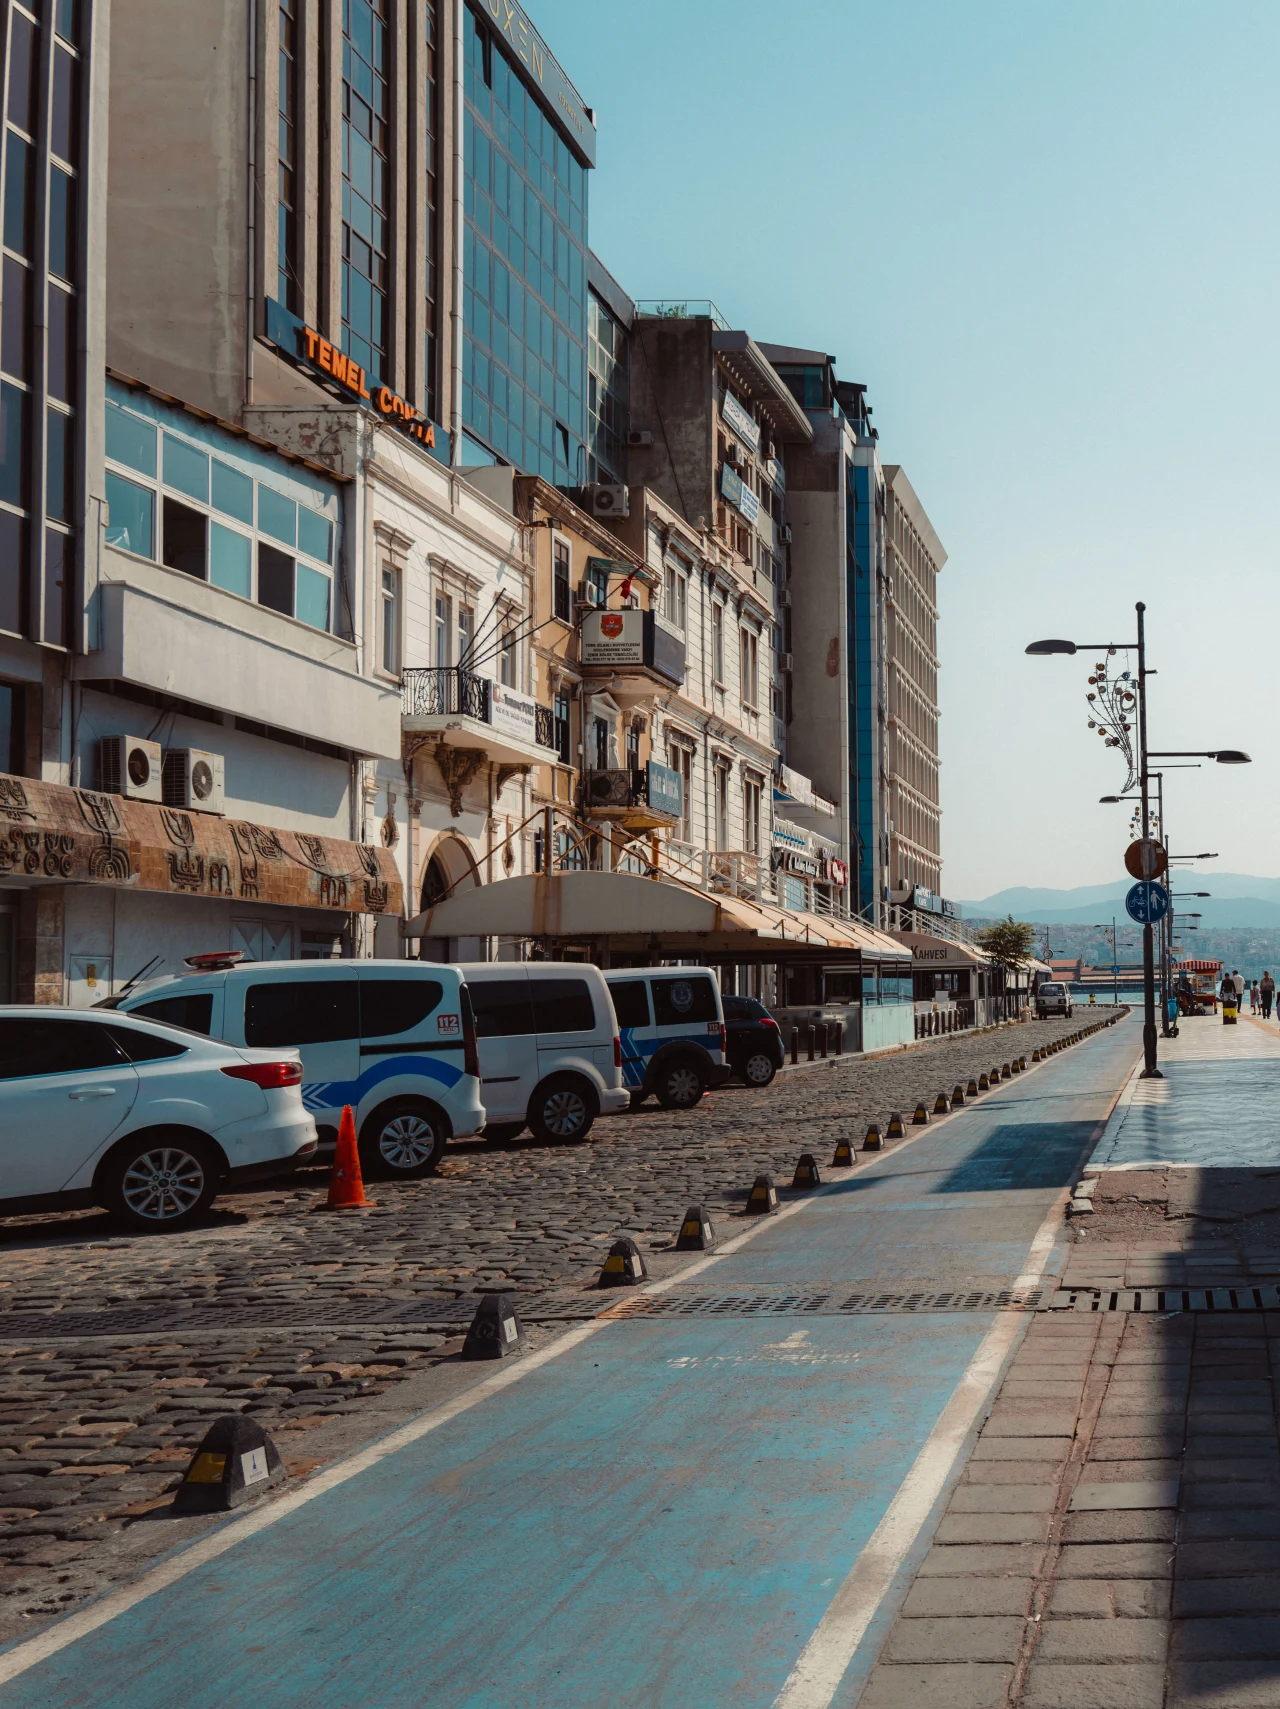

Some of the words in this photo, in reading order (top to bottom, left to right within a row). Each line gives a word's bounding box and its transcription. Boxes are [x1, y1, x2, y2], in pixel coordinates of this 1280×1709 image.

[301, 326, 371, 400] TEMEL
[911, 946, 947, 960] KAHVESİ
[438, 1016, 458, 1027] 112
[708, 1023, 719, 1031] 112
